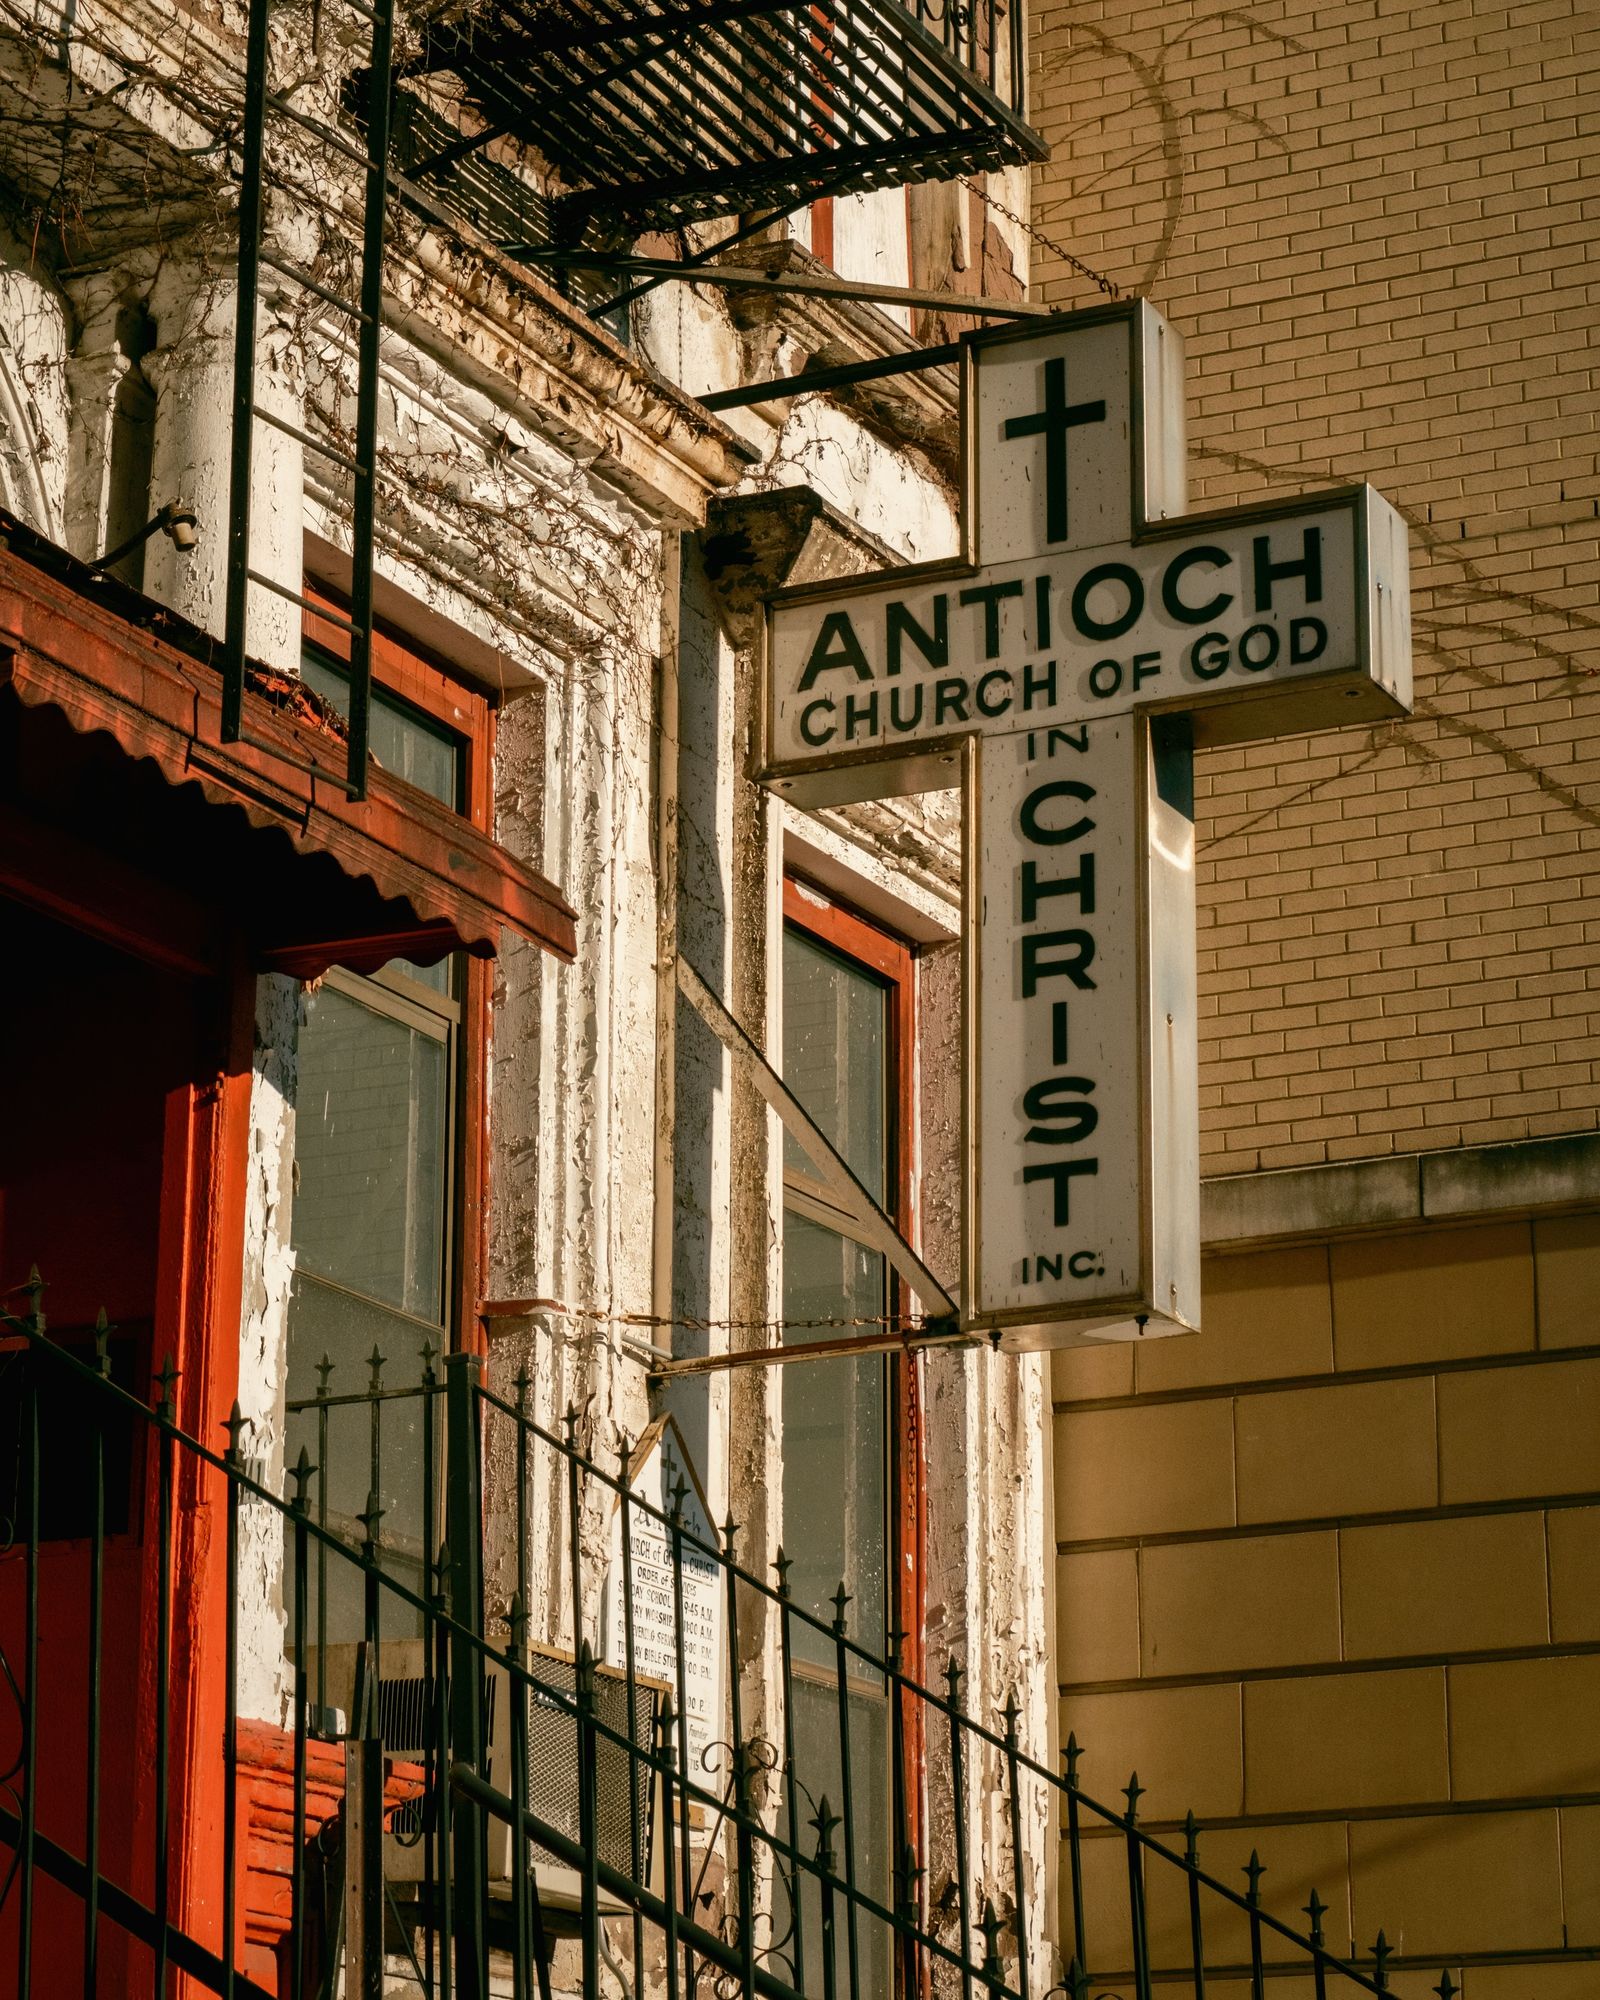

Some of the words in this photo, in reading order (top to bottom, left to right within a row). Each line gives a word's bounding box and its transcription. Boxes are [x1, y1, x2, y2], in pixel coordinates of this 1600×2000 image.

[798, 526, 1323, 693] ANTIOCH
[800, 660, 1057, 746] CHURCH
[1089, 651, 1161, 698] OF
[1191, 616, 1328, 680] GOD
[1027, 725, 1089, 761] IN
[1020, 780, 1098, 1227] CHRIST
[1022, 1251, 1106, 1286] INC.
[637, 1566, 659, 1585] ORDER
